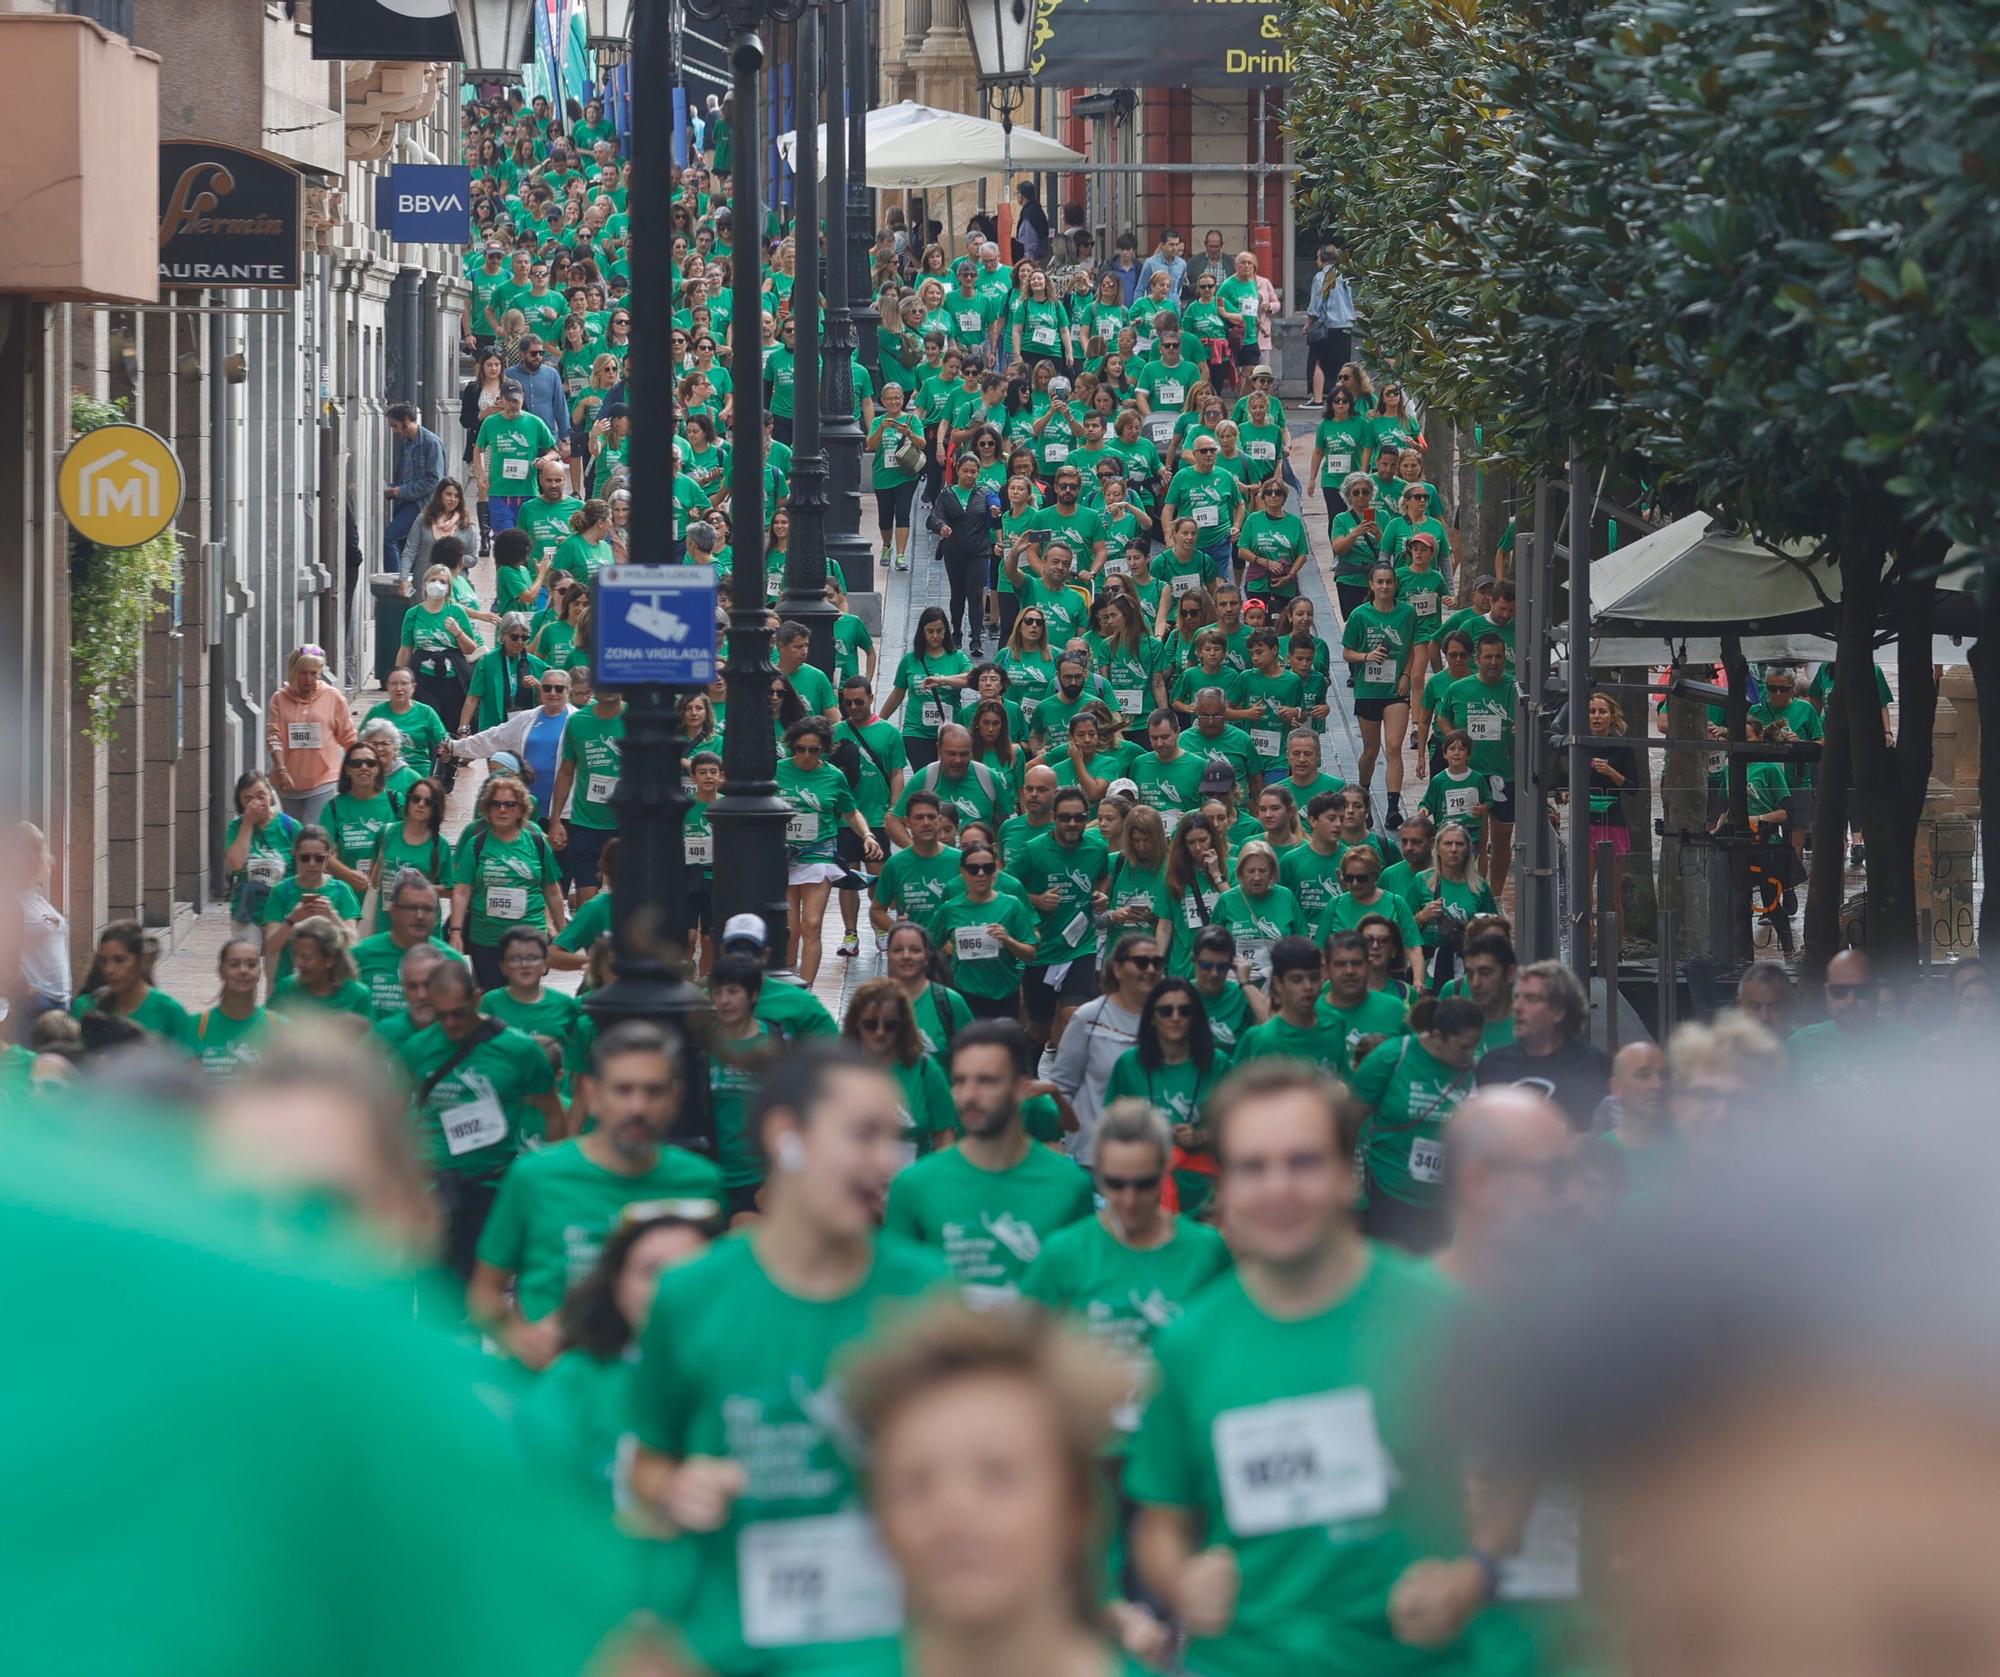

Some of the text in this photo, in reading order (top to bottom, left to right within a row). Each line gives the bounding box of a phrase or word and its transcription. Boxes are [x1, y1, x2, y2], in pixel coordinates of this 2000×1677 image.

[1260, 14, 1281, 38] &
[1226, 50, 1296, 73] Drink
[399, 194, 462, 212] BBVA
[603, 647, 709, 659] ZONA VIGILADA
[1368, 666, 1382, 675] 510
[925, 710, 940, 719] 656
[1471, 723, 1486, 733] 218
[591, 783, 606, 795] 410
[1450, 797, 1465, 808] 219
[688, 846, 705, 856] 408
[488, 897, 511, 909] 1655
[958, 938, 982, 950] 1066
